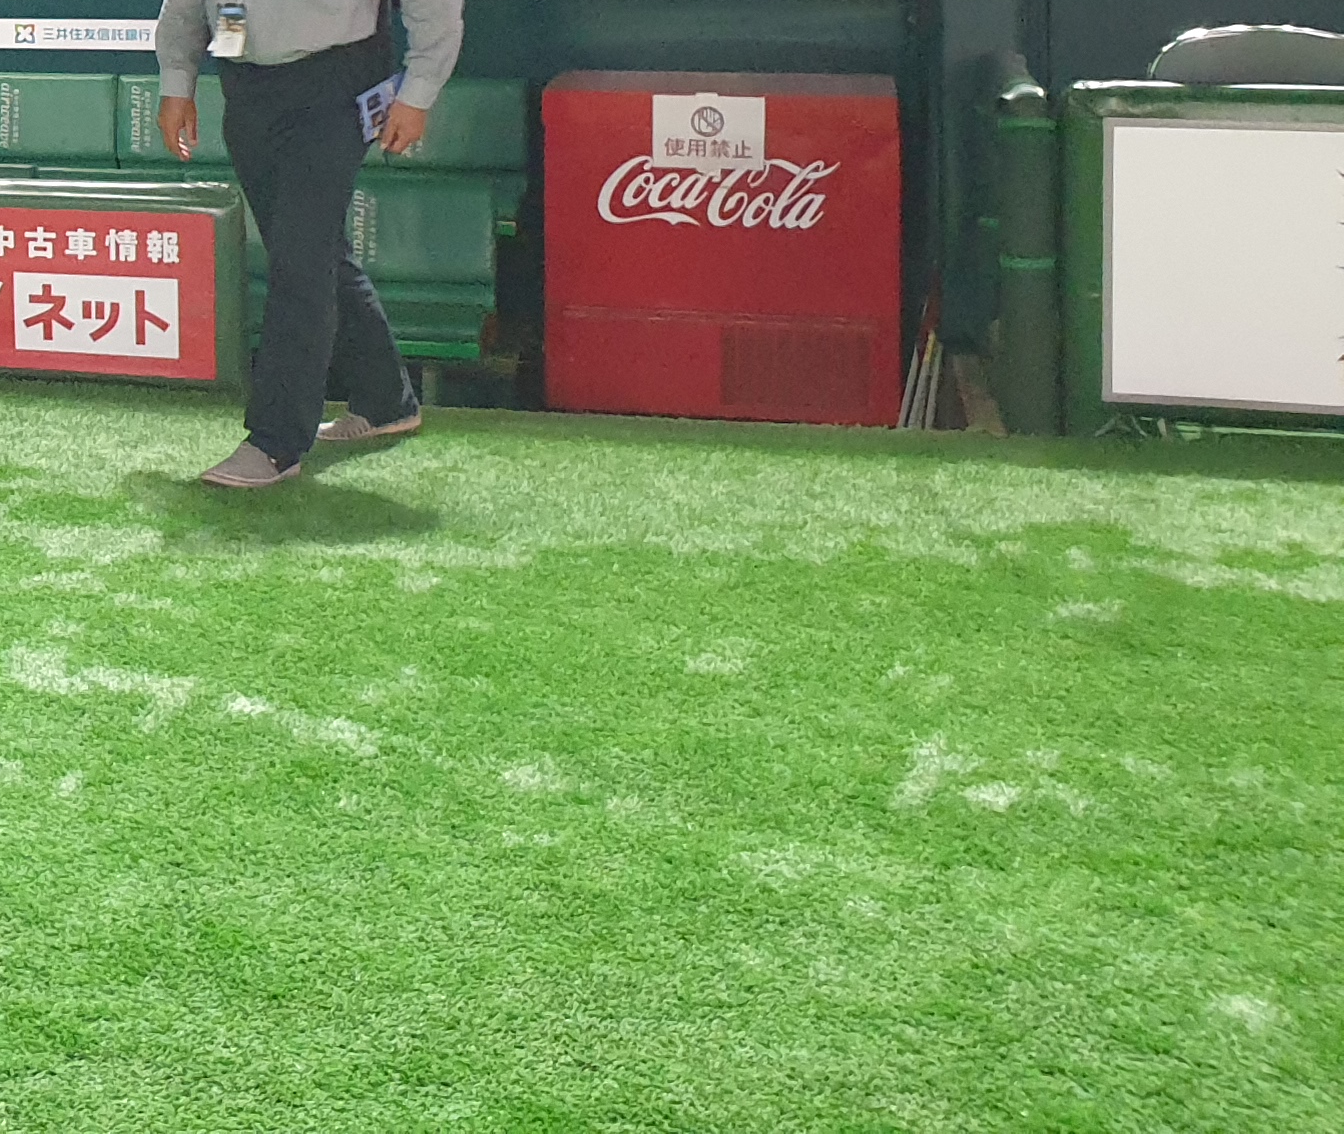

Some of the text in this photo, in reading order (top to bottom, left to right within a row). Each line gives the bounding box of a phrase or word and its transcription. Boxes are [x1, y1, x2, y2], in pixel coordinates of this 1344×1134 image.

[42, 27, 151, 42] 三井住友信託銀行
[0, 82, 10, 149] airweave
[130, 85, 142, 154] airweave
[664, 138, 753, 159] 使用禁止
[23, 283, 171, 346] ネット
